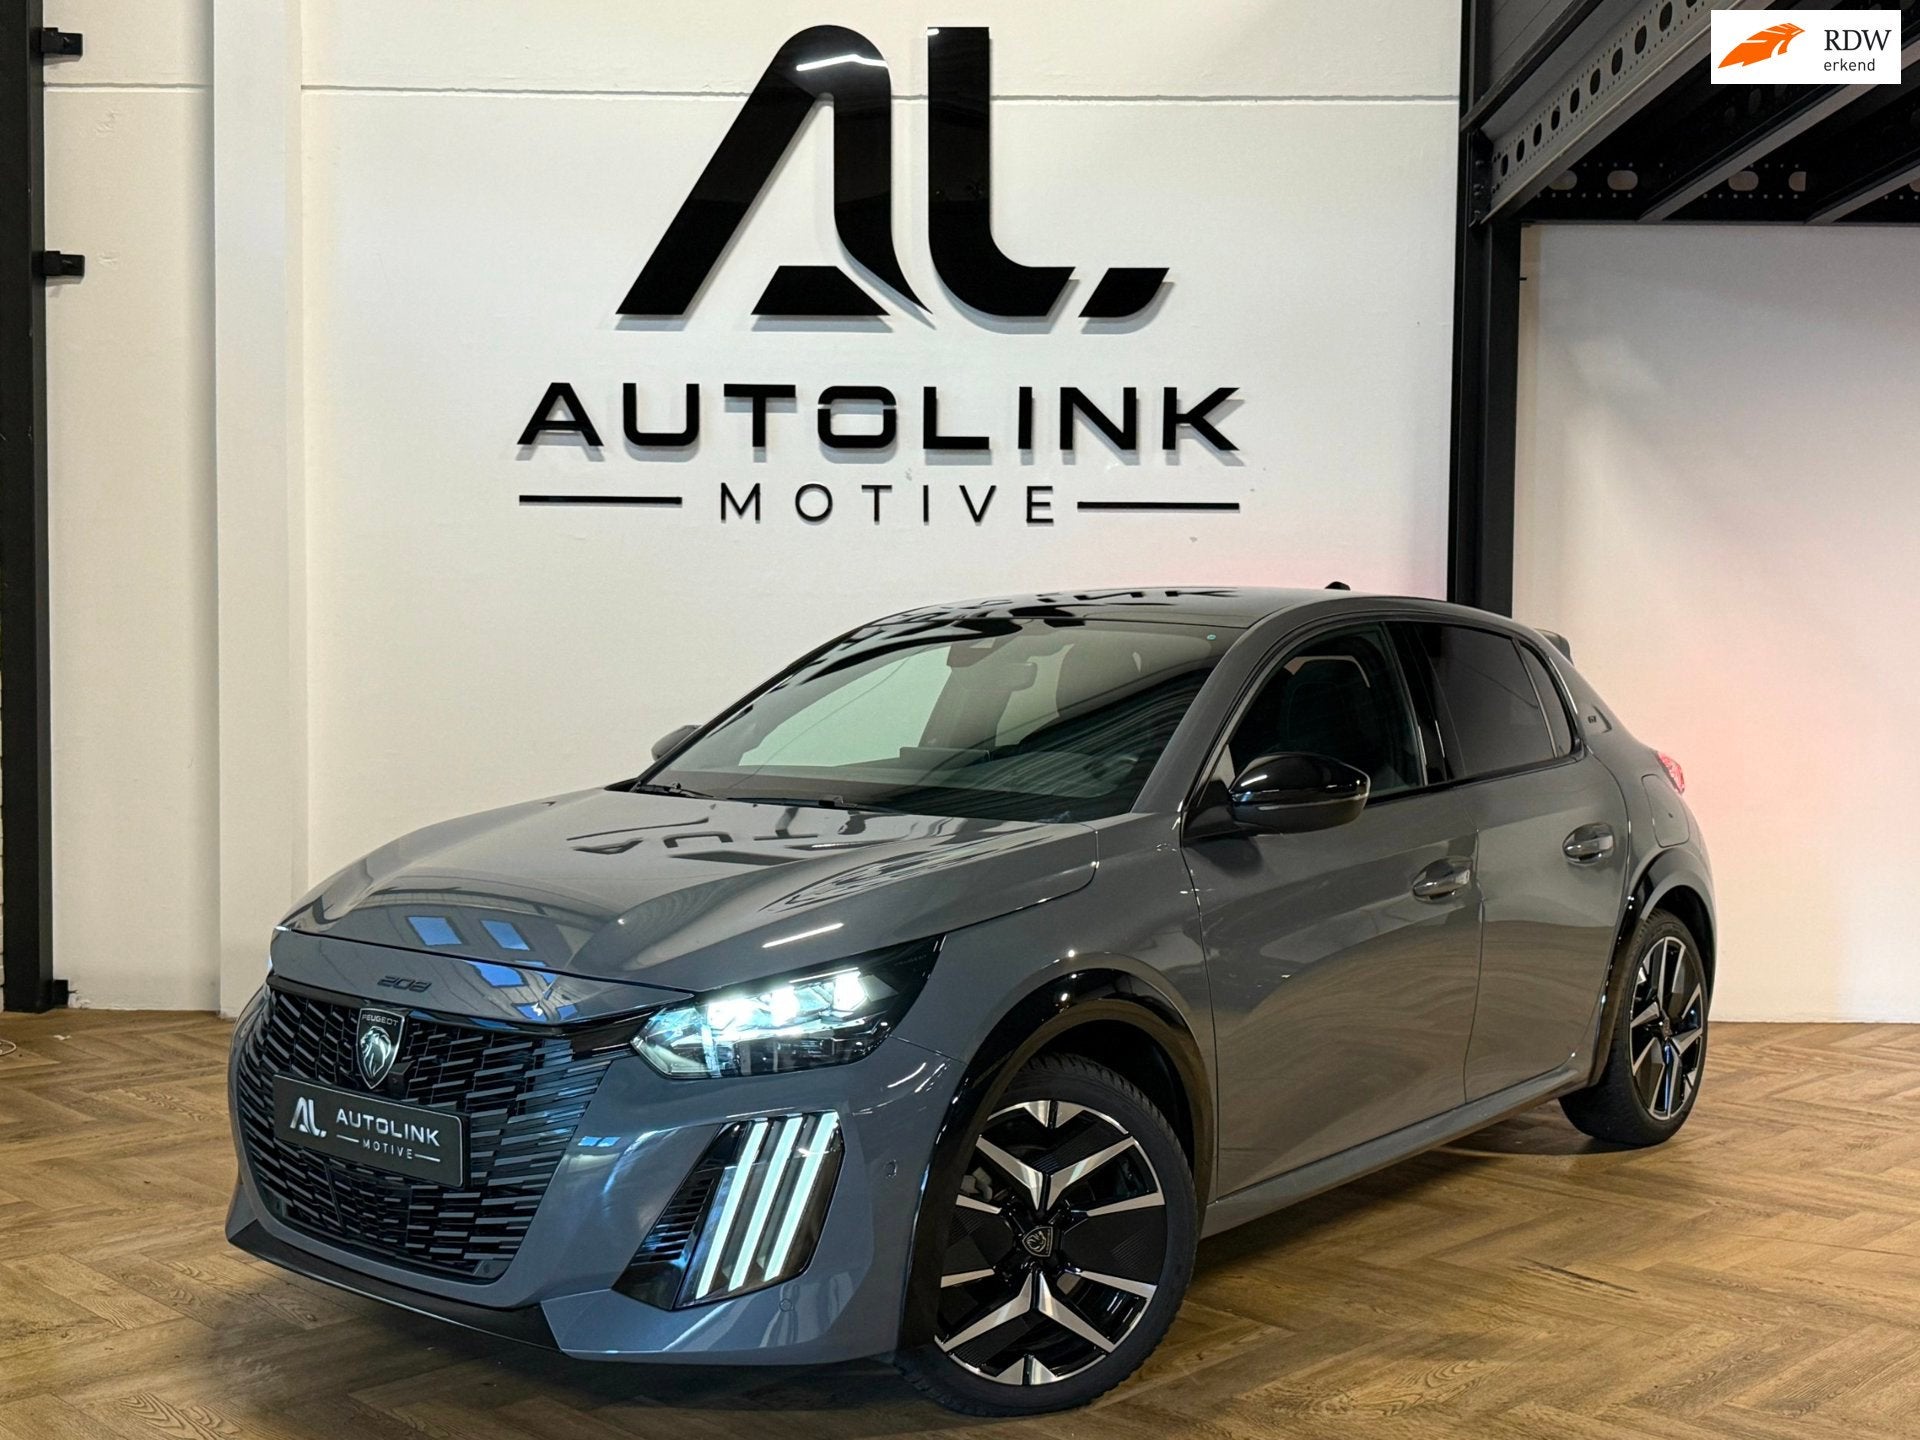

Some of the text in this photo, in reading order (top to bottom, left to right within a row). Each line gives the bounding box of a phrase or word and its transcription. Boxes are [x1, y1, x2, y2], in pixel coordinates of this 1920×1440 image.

[517, 382, 1241, 451] AUTOLINK
[720, 482, 1054, 524] MOTIVE
[377, 975, 432, 993] 208
[361, 1013, 399, 1027] PEUGEOT
[335, 1107, 442, 1148] AUTOLINK
[362, 1137, 414, 1160] MOTIVE
